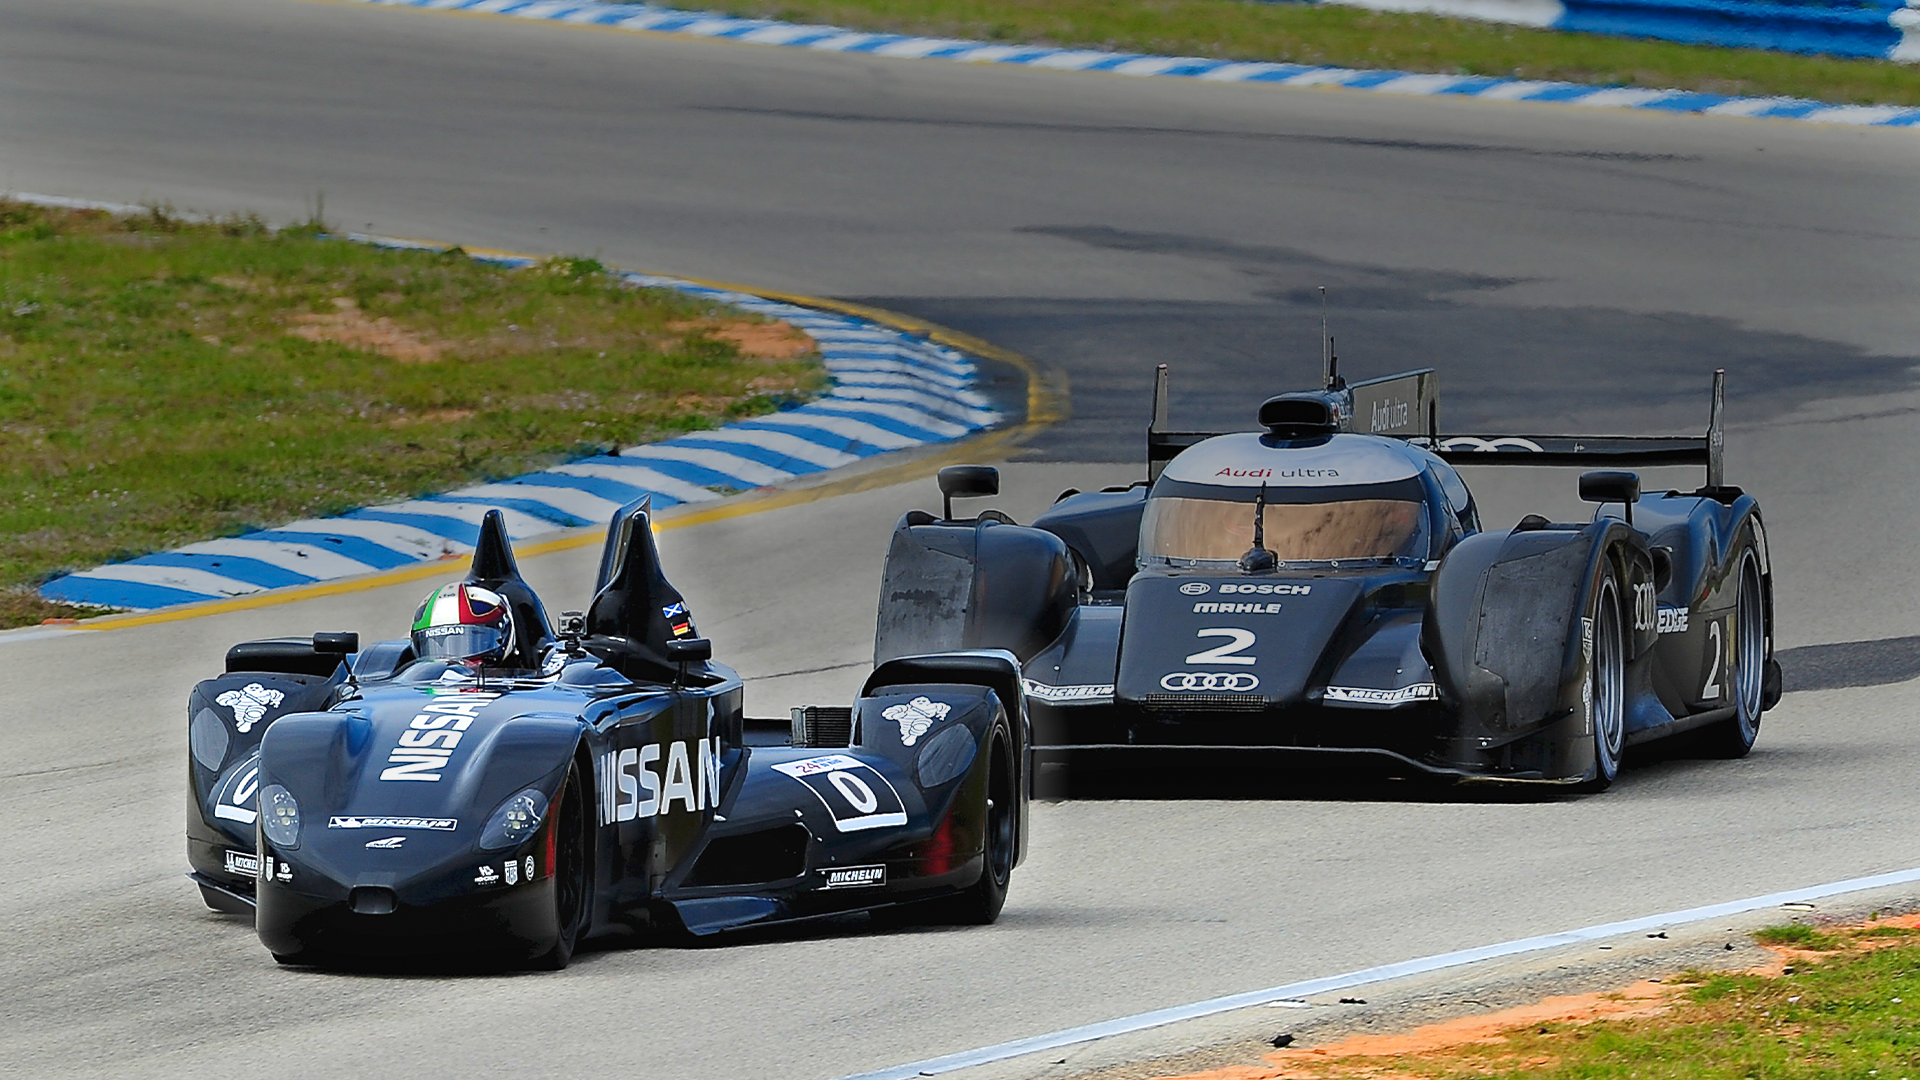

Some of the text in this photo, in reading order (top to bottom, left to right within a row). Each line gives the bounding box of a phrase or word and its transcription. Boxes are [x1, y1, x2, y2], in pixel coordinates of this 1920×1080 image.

[1215, 467, 1340, 478] Audi ultra
[1218, 584, 1312, 596] BOSCH
[1192, 602, 1282, 614] MAHLE
[425, 626, 465, 638] NISSAN
[1185, 627, 1257, 666] 2
[1701, 620, 1722, 700] 2
[1033, 684, 1115, 698] MICHELIN
[1347, 686, 1433, 700] MICHELIN
[380, 692, 502, 782] NISSAN
[600, 735, 720, 828] NISSAN
[826, 770, 878, 814] 0
[360, 818, 453, 829] MICHELIN
[830, 868, 883, 883] MICHELIN
